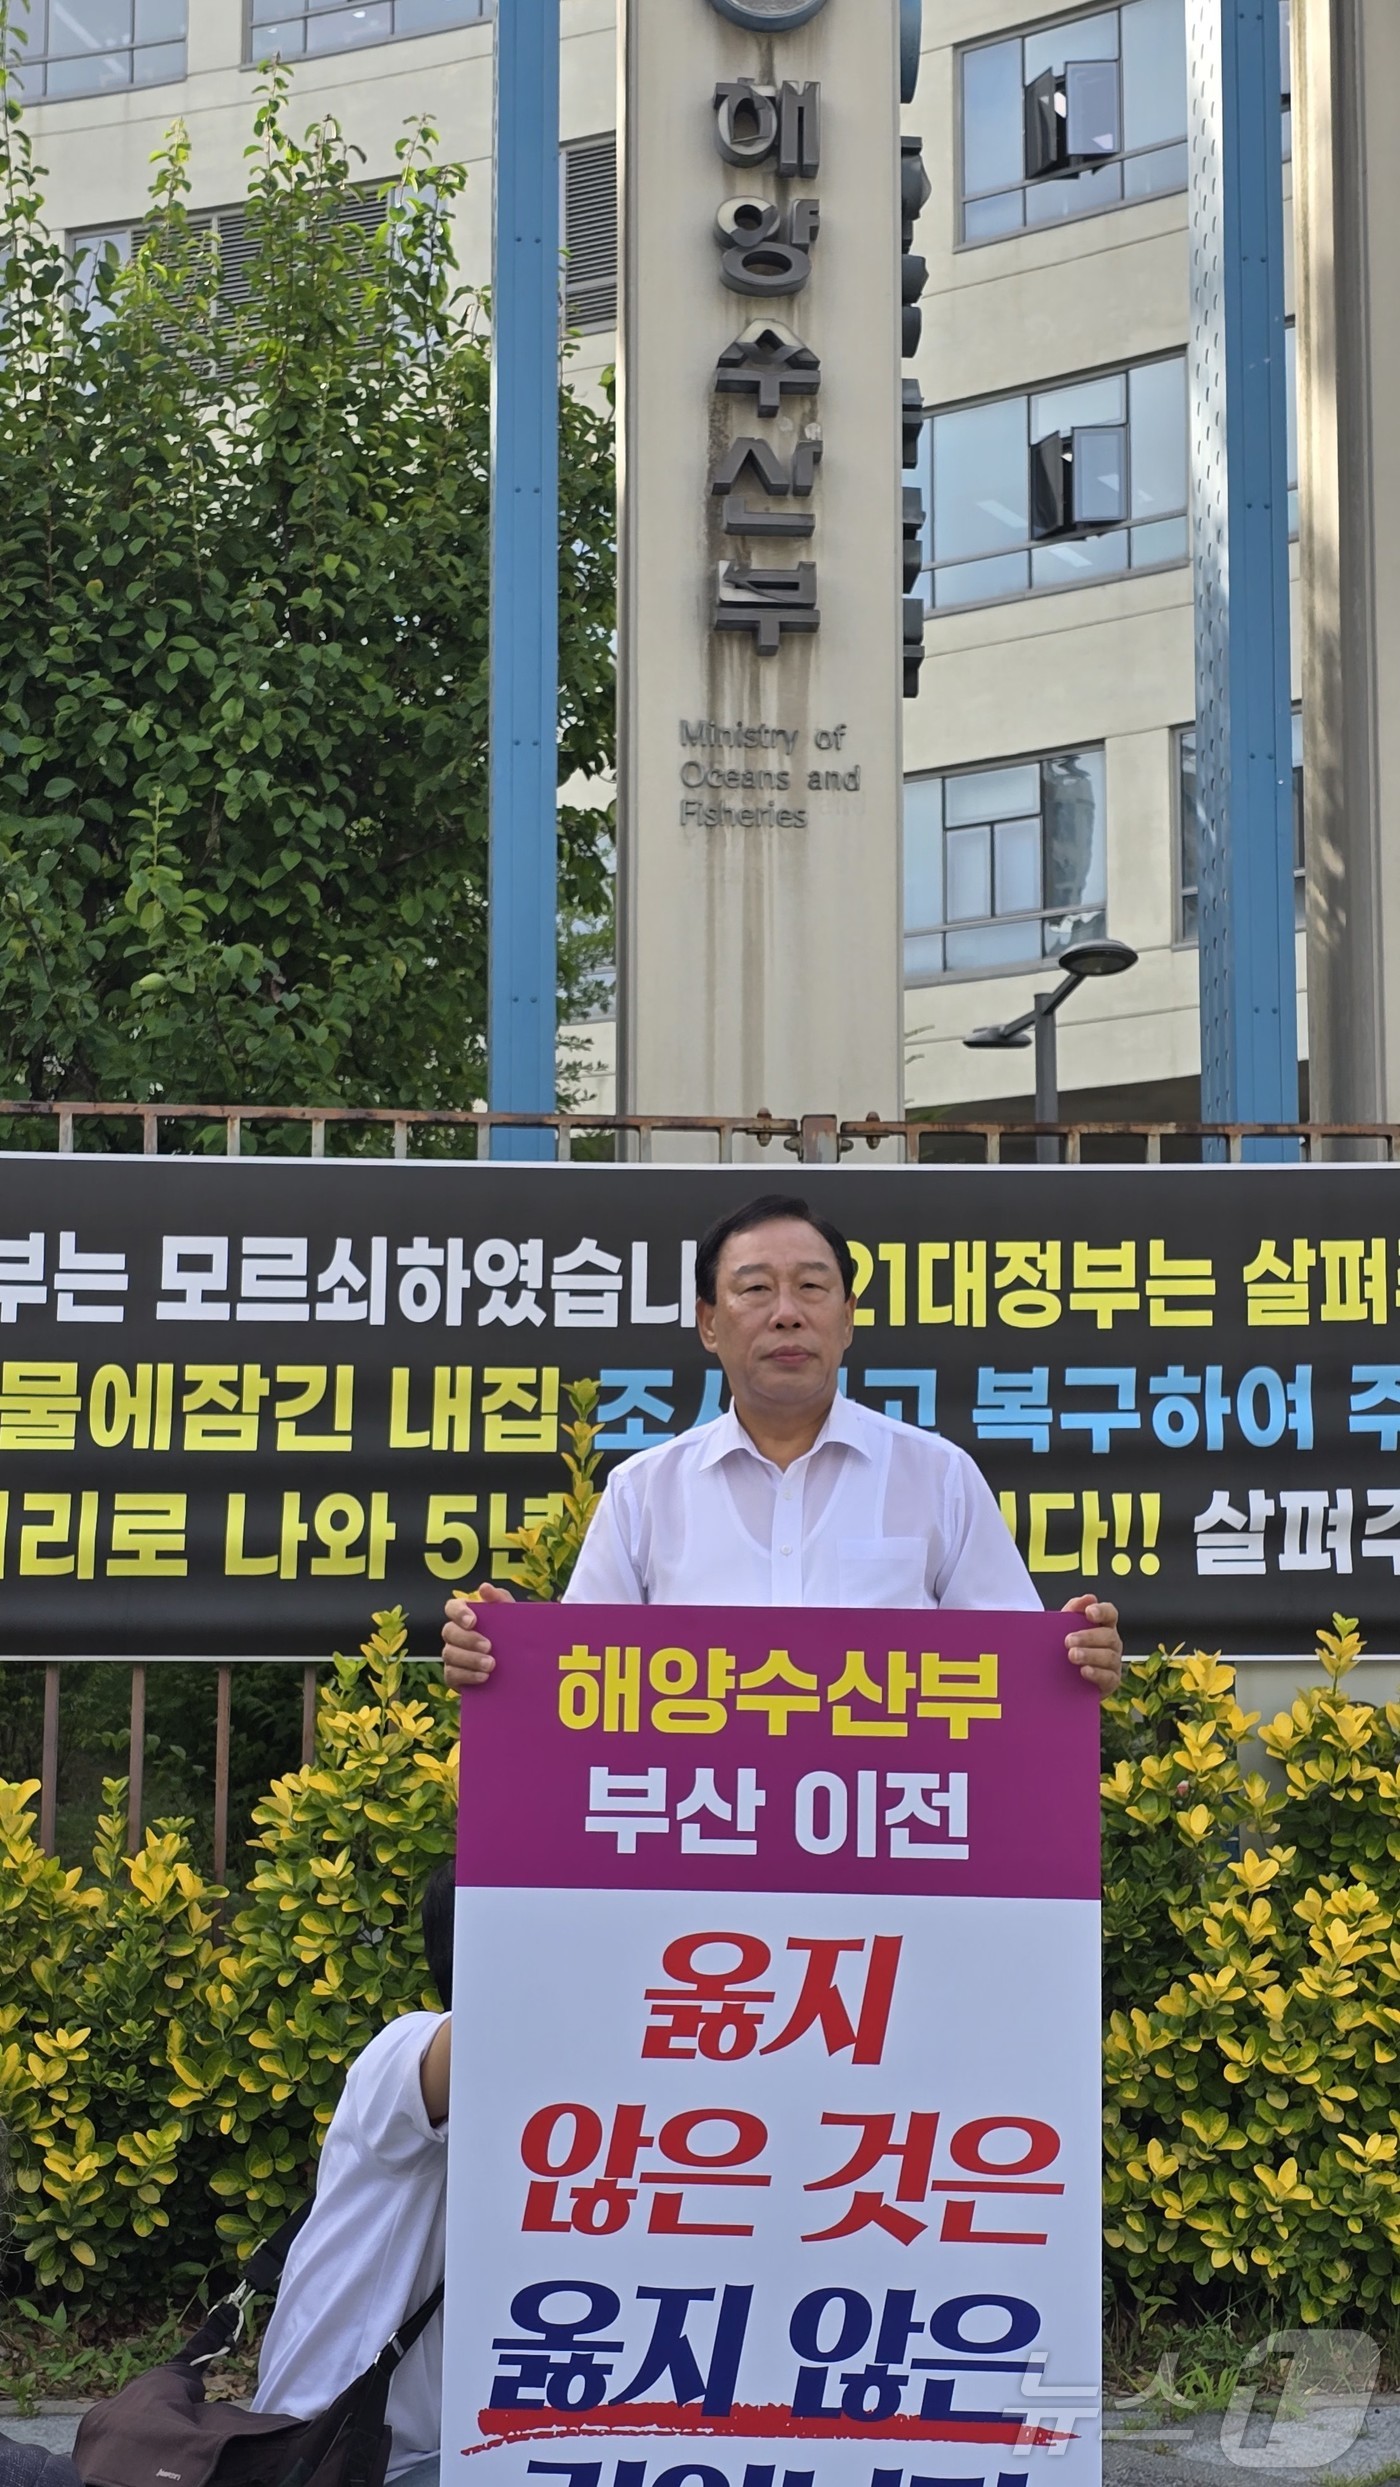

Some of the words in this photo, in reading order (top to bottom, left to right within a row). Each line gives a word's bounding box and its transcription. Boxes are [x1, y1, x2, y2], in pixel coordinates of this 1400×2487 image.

[712, 79, 822, 656] 해양수산부
[679, 720, 799, 755] Ministry
[815, 723, 847, 750] of
[680, 761, 790, 790] Oceans
[807, 765, 861, 791] and
[679, 800, 808, 828] Fisheries
[0, 1231, 128, 1323] 부는
[1243, 1237, 1400, 1326] 살펴
[0, 1361, 354, 1452] 물에잠긴
[389, 1366, 560, 1453] 내집
[972, 1364, 1314, 1453] 복구하여
[0, 1491, 188, 1580] 리로
[225, 1492, 395, 1580] 나와
[1000, 1490, 1161, 1577] 다!!
[557, 1644, 1002, 1740] 해양수산부
[584, 1766, 766, 1856] 부산
[795, 1769, 969, 1860] 이전
[641, 1931, 904, 2066] 옳지
[520, 2102, 772, 2237] 않은
[800, 2111, 1066, 2247] 것은
[488, 2280, 755, 2418] 옳지
[788, 2287, 1046, 2425] 않은
